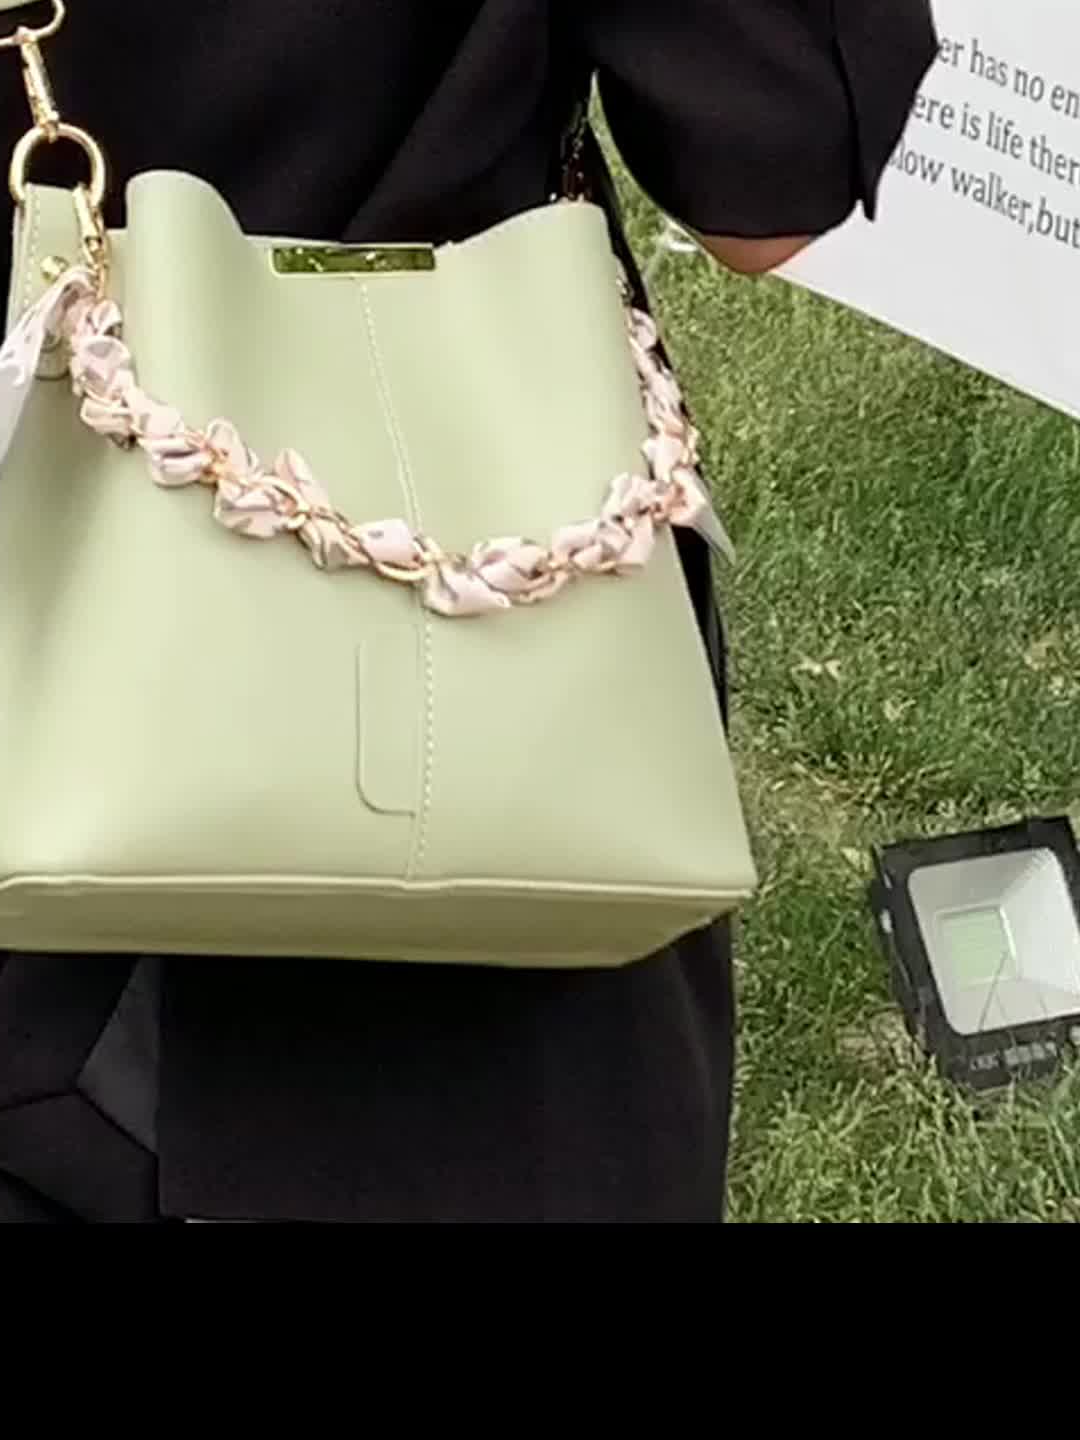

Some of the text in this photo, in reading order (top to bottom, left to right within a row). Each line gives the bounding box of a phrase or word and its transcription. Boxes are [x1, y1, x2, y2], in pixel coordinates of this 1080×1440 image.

[970, 38, 1008, 87] has
[1014, 67, 1045, 103] no
[888, 136, 944, 183] low
[960, 104, 981, 141] is
[986, 111, 1023, 160] life
[1029, 134, 1080, 186] ther
